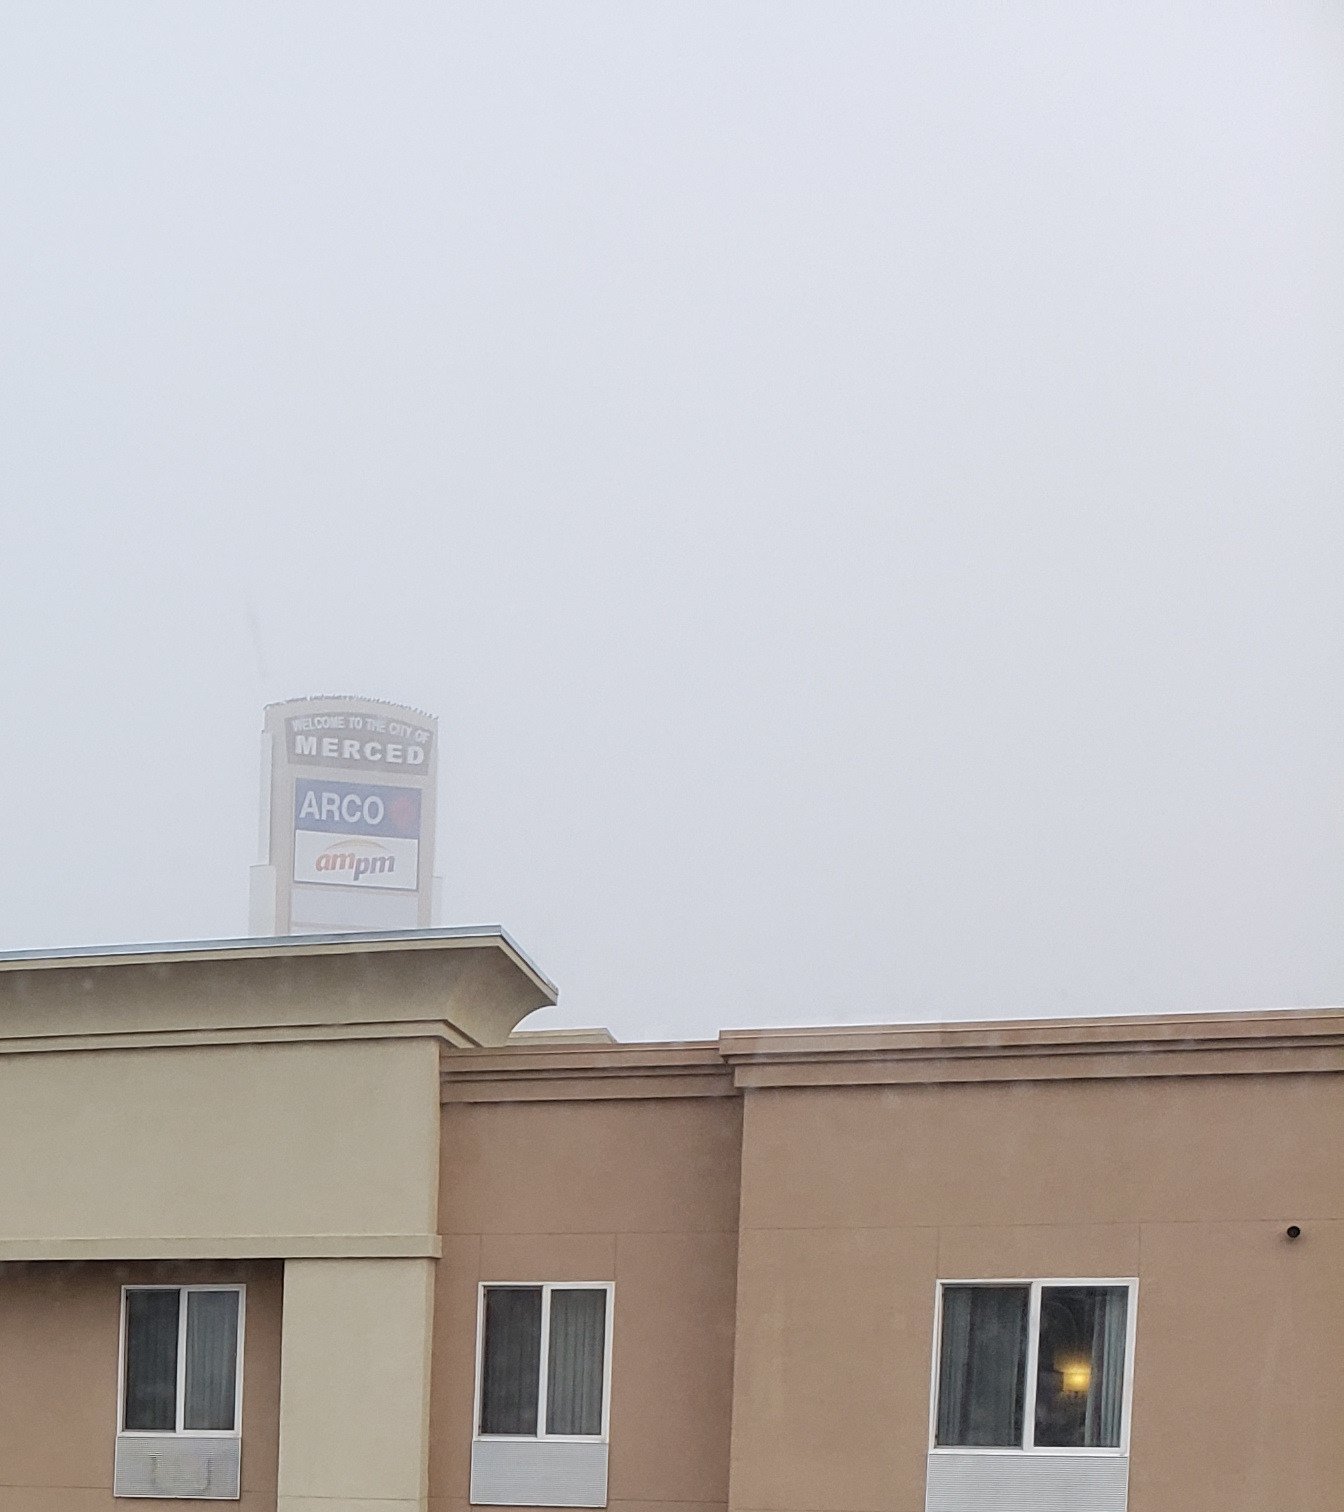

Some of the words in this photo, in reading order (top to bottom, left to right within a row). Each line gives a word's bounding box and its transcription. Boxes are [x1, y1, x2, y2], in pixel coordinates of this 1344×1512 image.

[292, 716, 345, 732] WELCOME
[349, 716, 363, 730] TO
[365, 718, 386, 733] THE
[389, 722, 413, 739] CITY
[414, 729, 432, 744] OF
[294, 735, 425, 765] MERCED
[299, 791, 385, 825] ARCO
[315, 852, 395, 882] ampm
